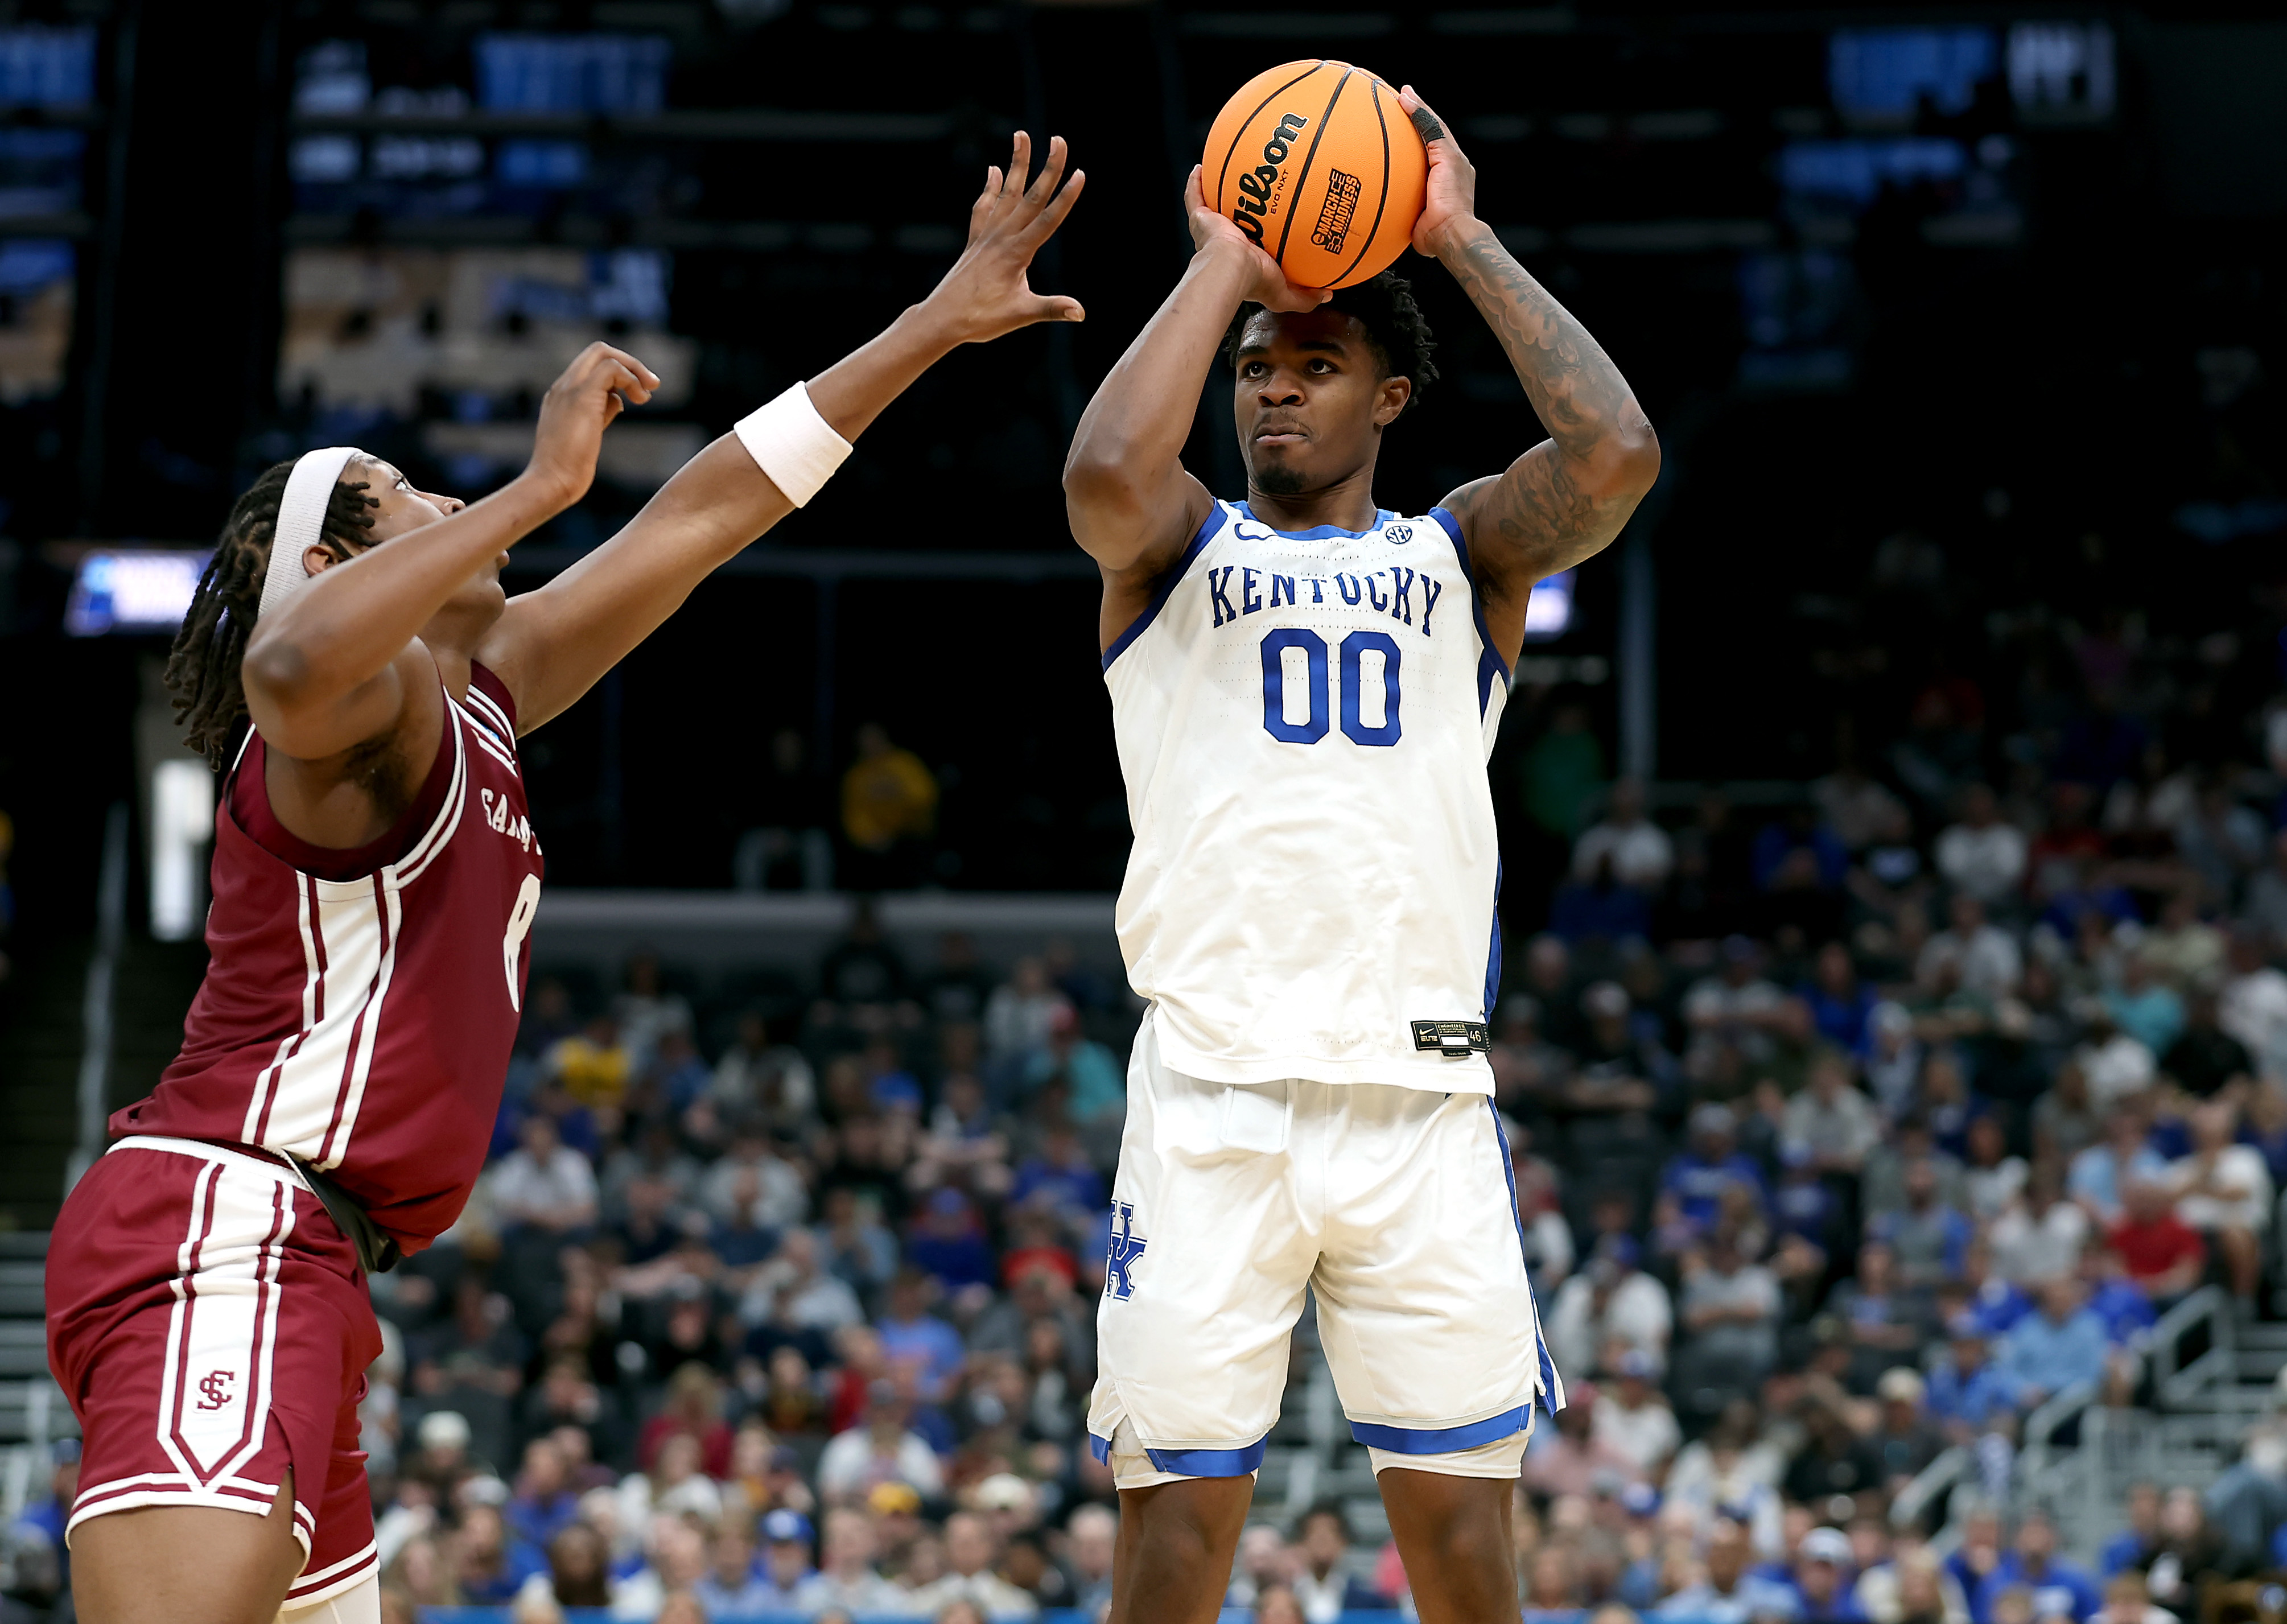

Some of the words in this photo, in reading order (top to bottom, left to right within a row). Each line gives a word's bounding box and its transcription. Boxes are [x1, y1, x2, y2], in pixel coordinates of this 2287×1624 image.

[1270, 193, 1280, 215] EVO
[1277, 169, 1289, 191] NXT
[1317, 191, 1341, 236] MARCH
[1331, 175, 1358, 234] MADNESS
[1386, 525, 1412, 545] SEC
[1208, 566, 1442, 637] KENTUCKY
[1260, 628, 1402, 747] 00
[1470, 1030, 1482, 1042] 46
